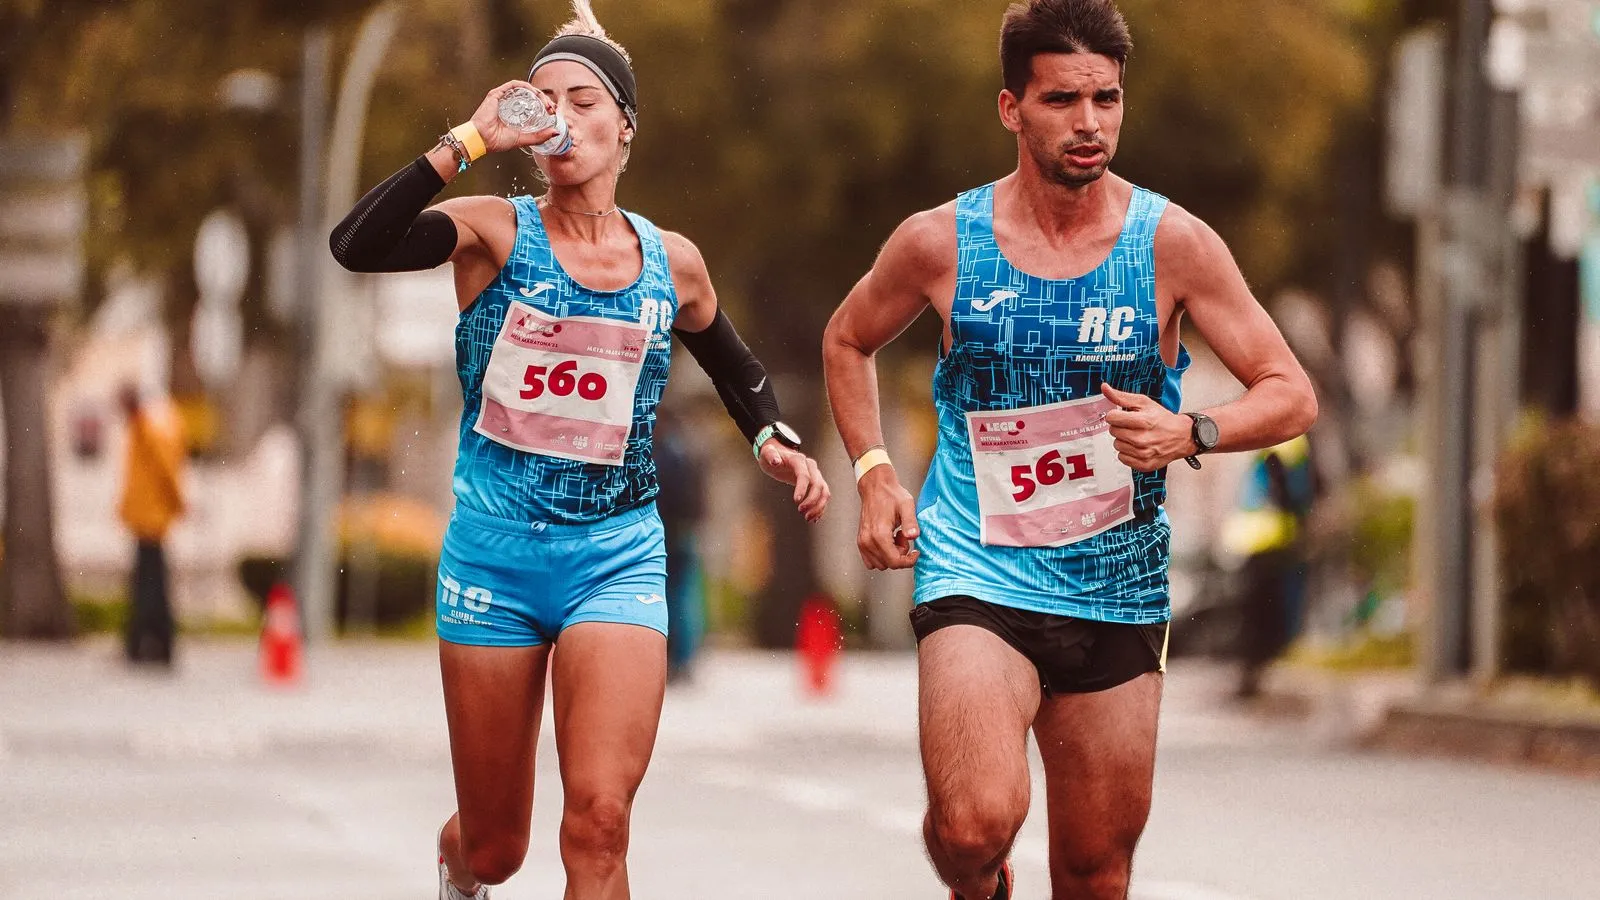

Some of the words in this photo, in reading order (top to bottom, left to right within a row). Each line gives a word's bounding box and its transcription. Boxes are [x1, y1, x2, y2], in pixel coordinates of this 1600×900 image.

[1077, 306, 1135, 342] RC
[519, 360, 607, 400] 560
[979, 420, 1025, 433] ALEGRO
[1080, 421, 1109, 434] MARATO
[1011, 449, 1094, 503] 561
